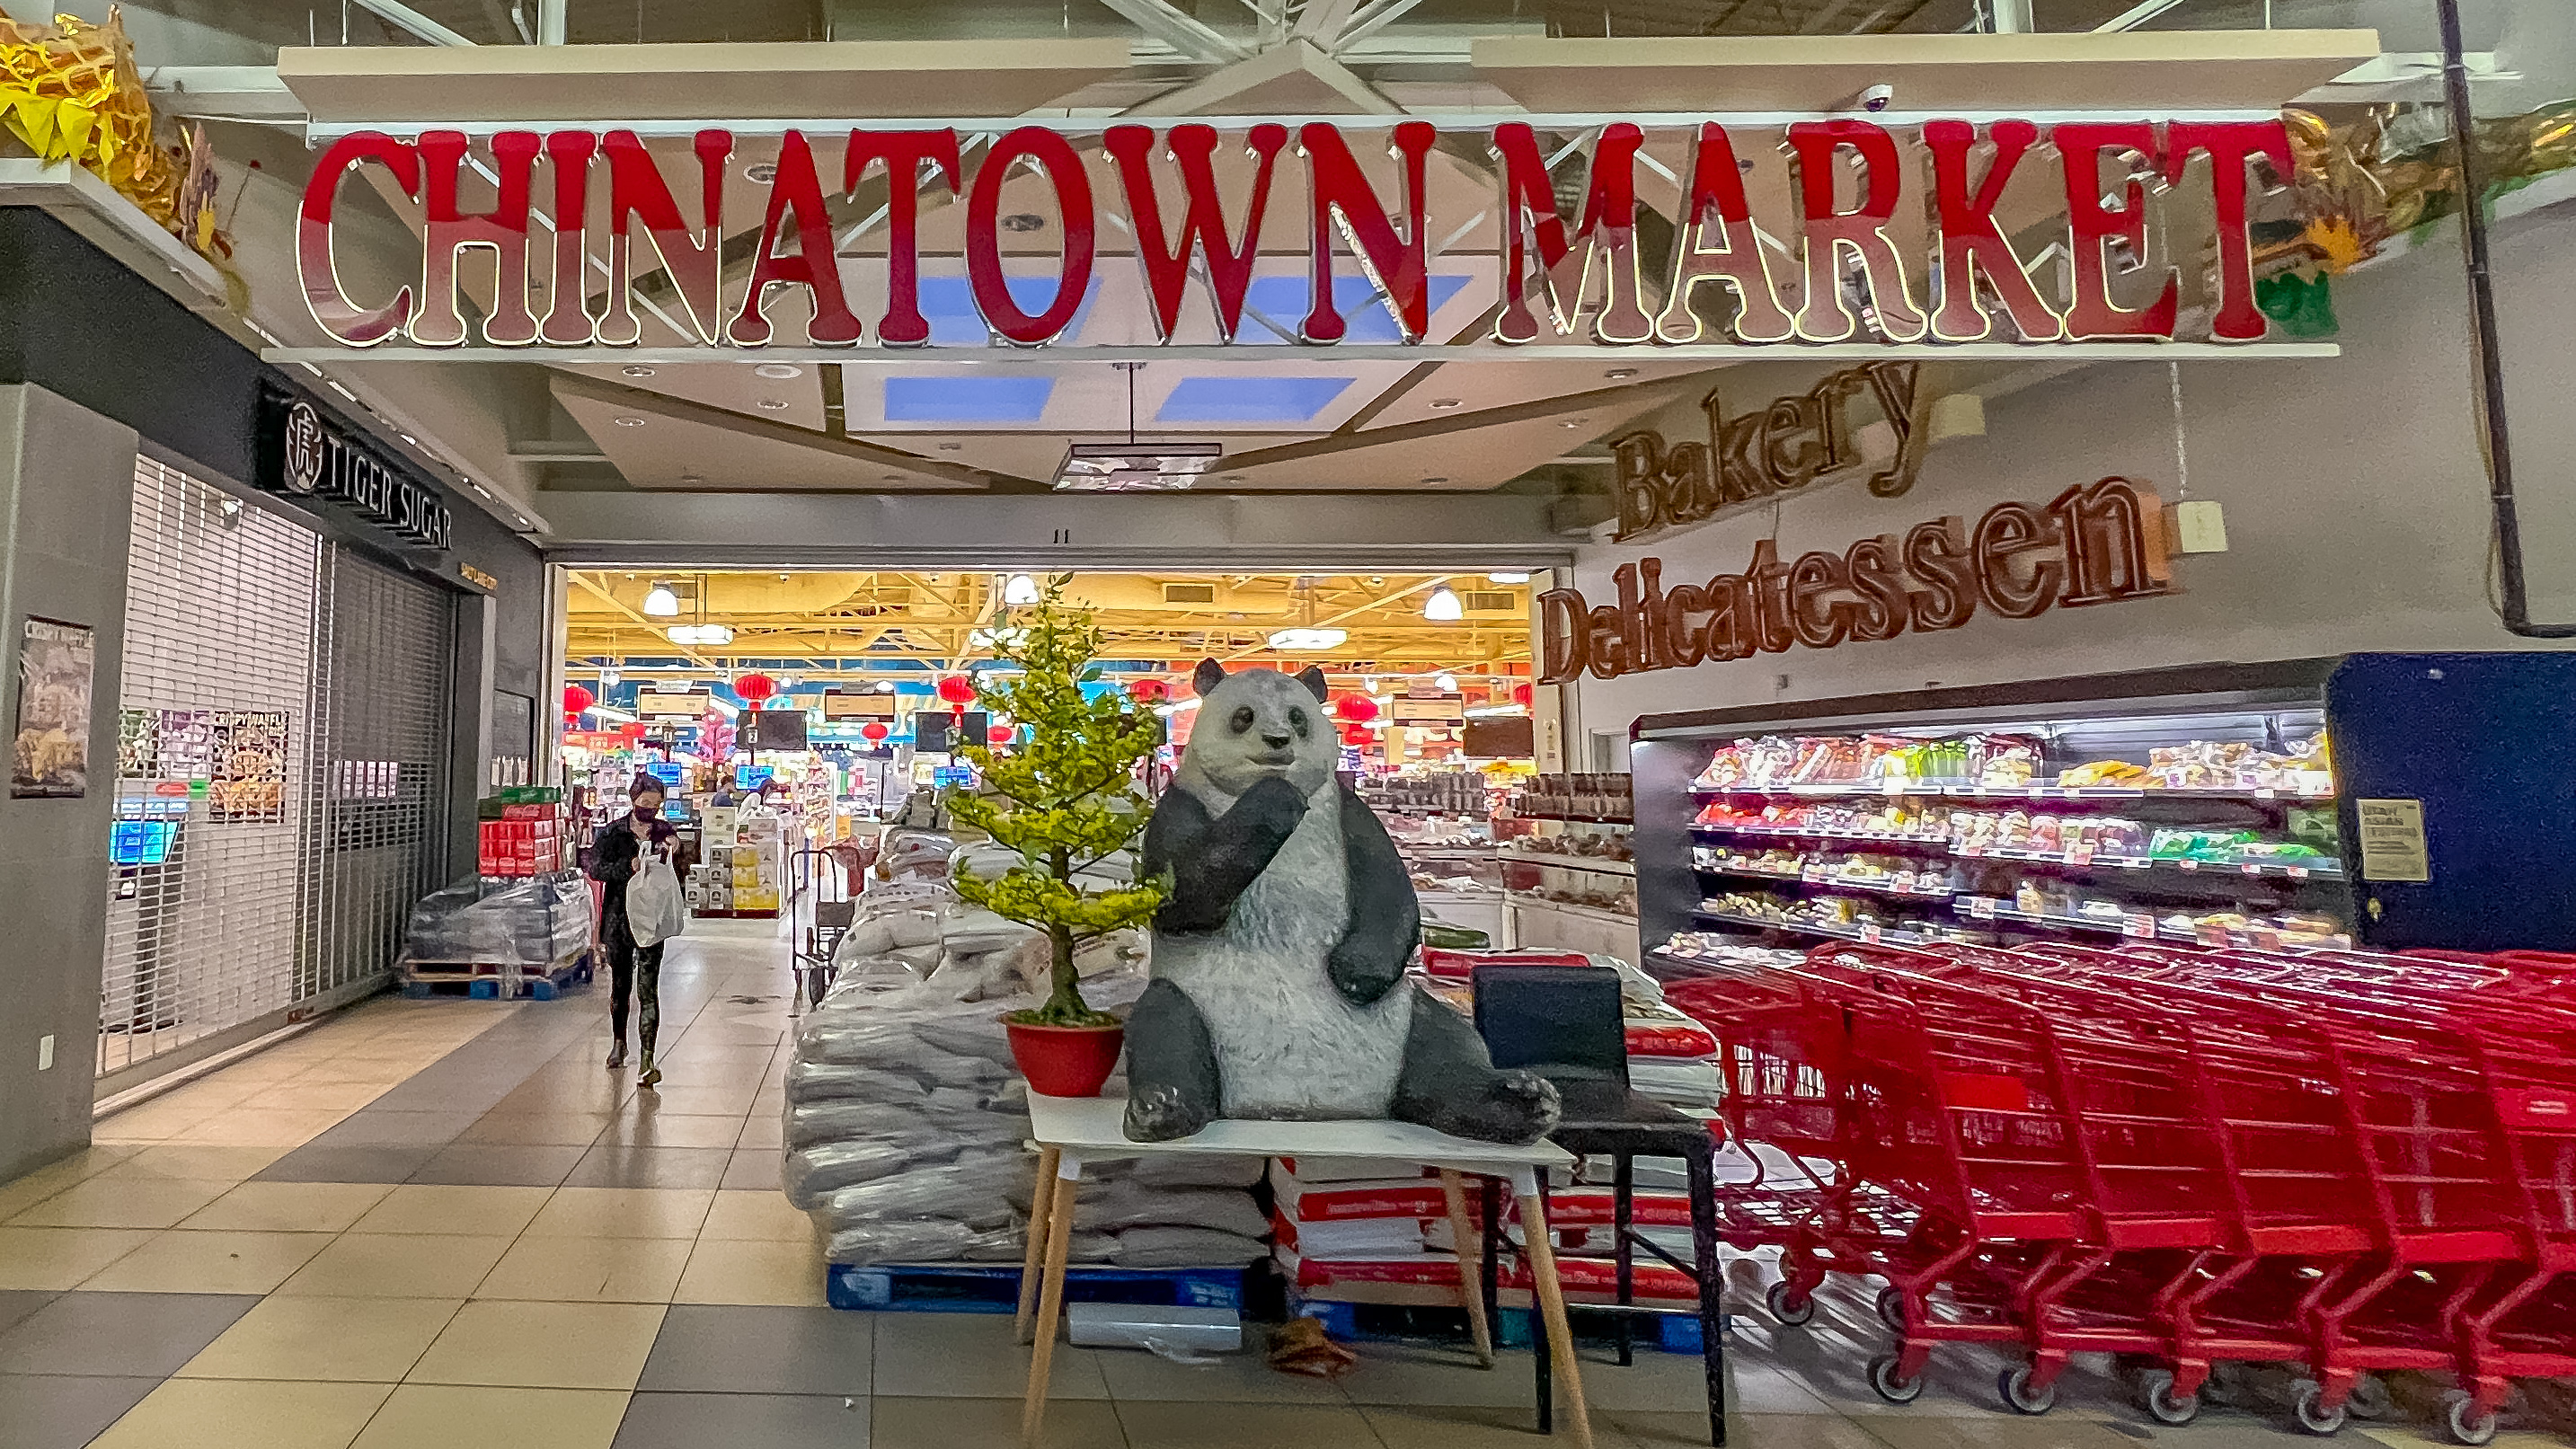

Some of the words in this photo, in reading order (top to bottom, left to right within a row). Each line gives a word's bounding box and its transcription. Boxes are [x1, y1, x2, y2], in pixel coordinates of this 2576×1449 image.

[294, 122, 1437, 347] CHINATOWN
[1490, 119, 2295, 346] MARKET
[327, 435, 392, 521] TIGER
[400, 482, 452, 551] SUGAR
[1609, 360, 1921, 543] Bakery
[1536, 475, 2158, 685] Delicatessen
